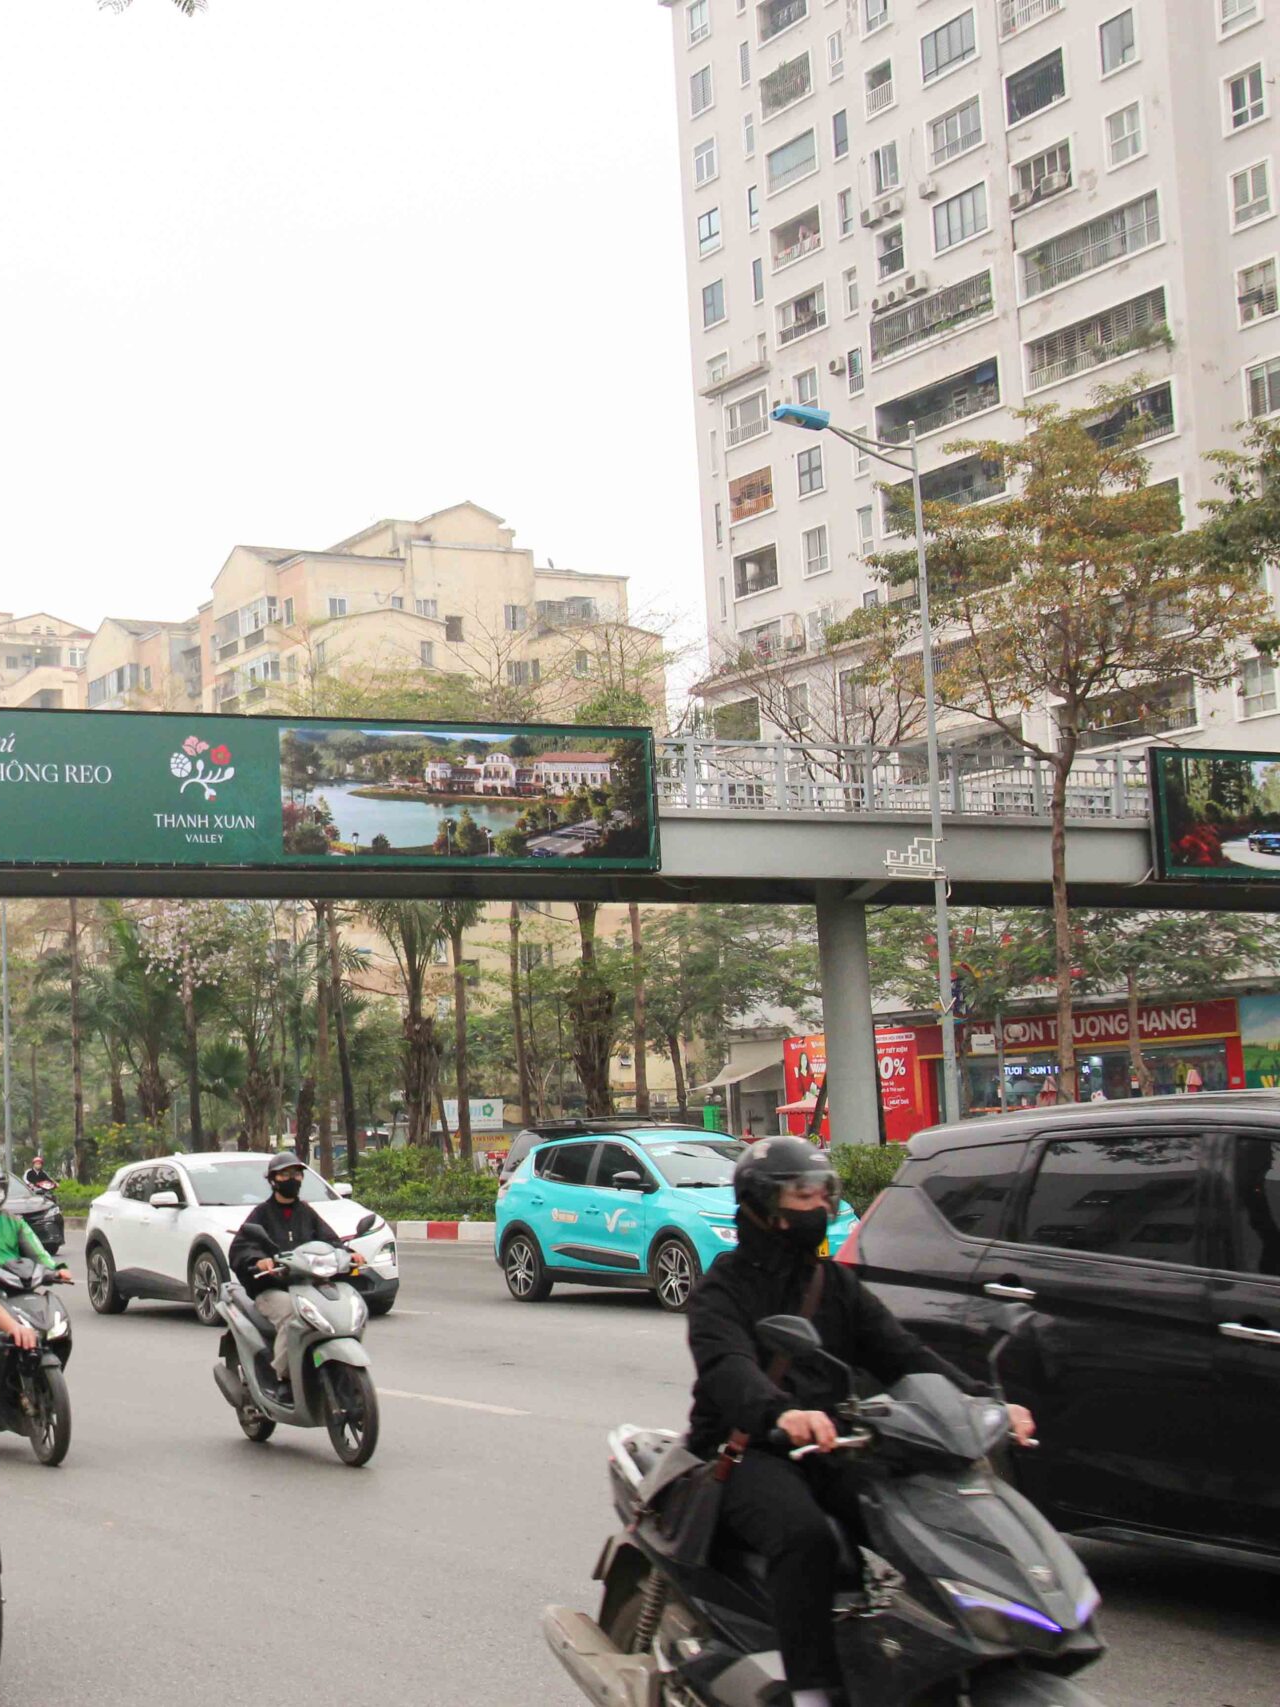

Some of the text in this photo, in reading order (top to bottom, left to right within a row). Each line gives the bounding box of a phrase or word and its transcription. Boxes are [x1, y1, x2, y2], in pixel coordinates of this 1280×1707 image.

[65, 764, 112, 784] REO
[153, 813, 255, 829] THANH XUAN
[185, 833, 224, 844] VALLEY
[878, 1056, 906, 1079] 0%
